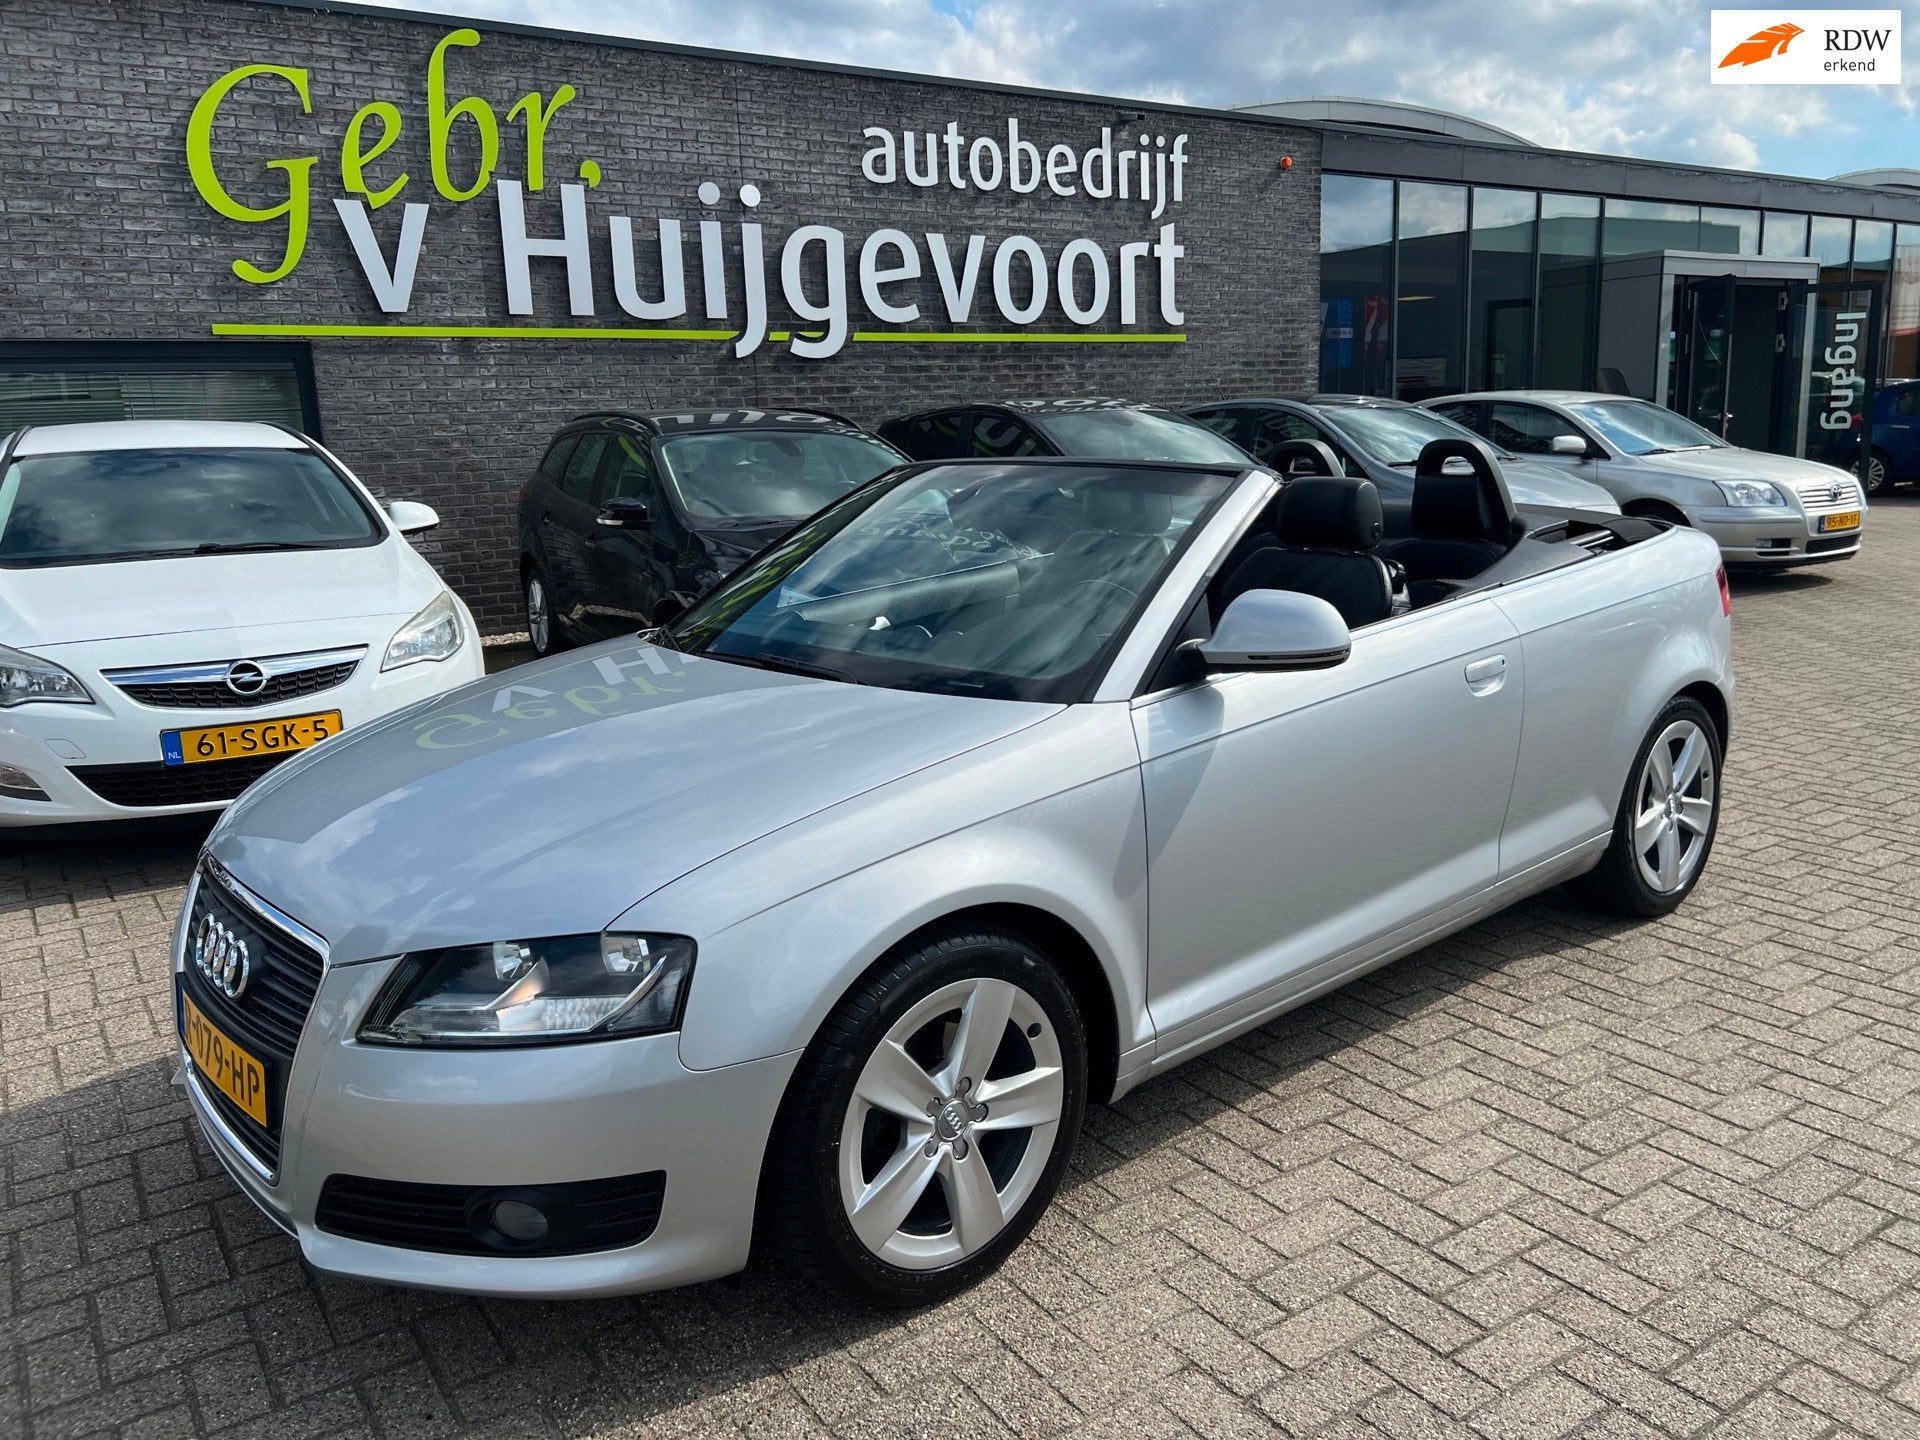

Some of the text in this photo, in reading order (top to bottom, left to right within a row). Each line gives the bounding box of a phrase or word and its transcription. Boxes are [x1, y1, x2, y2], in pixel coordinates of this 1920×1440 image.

[186, 28, 601, 284] Gebr.
[862, 117, 1187, 219] autobedrijf
[332, 179, 1185, 359] v Huijgevoort
[1820, 312, 1867, 430] Ingang
[197, 719, 329, 756] 61-SGK-5
